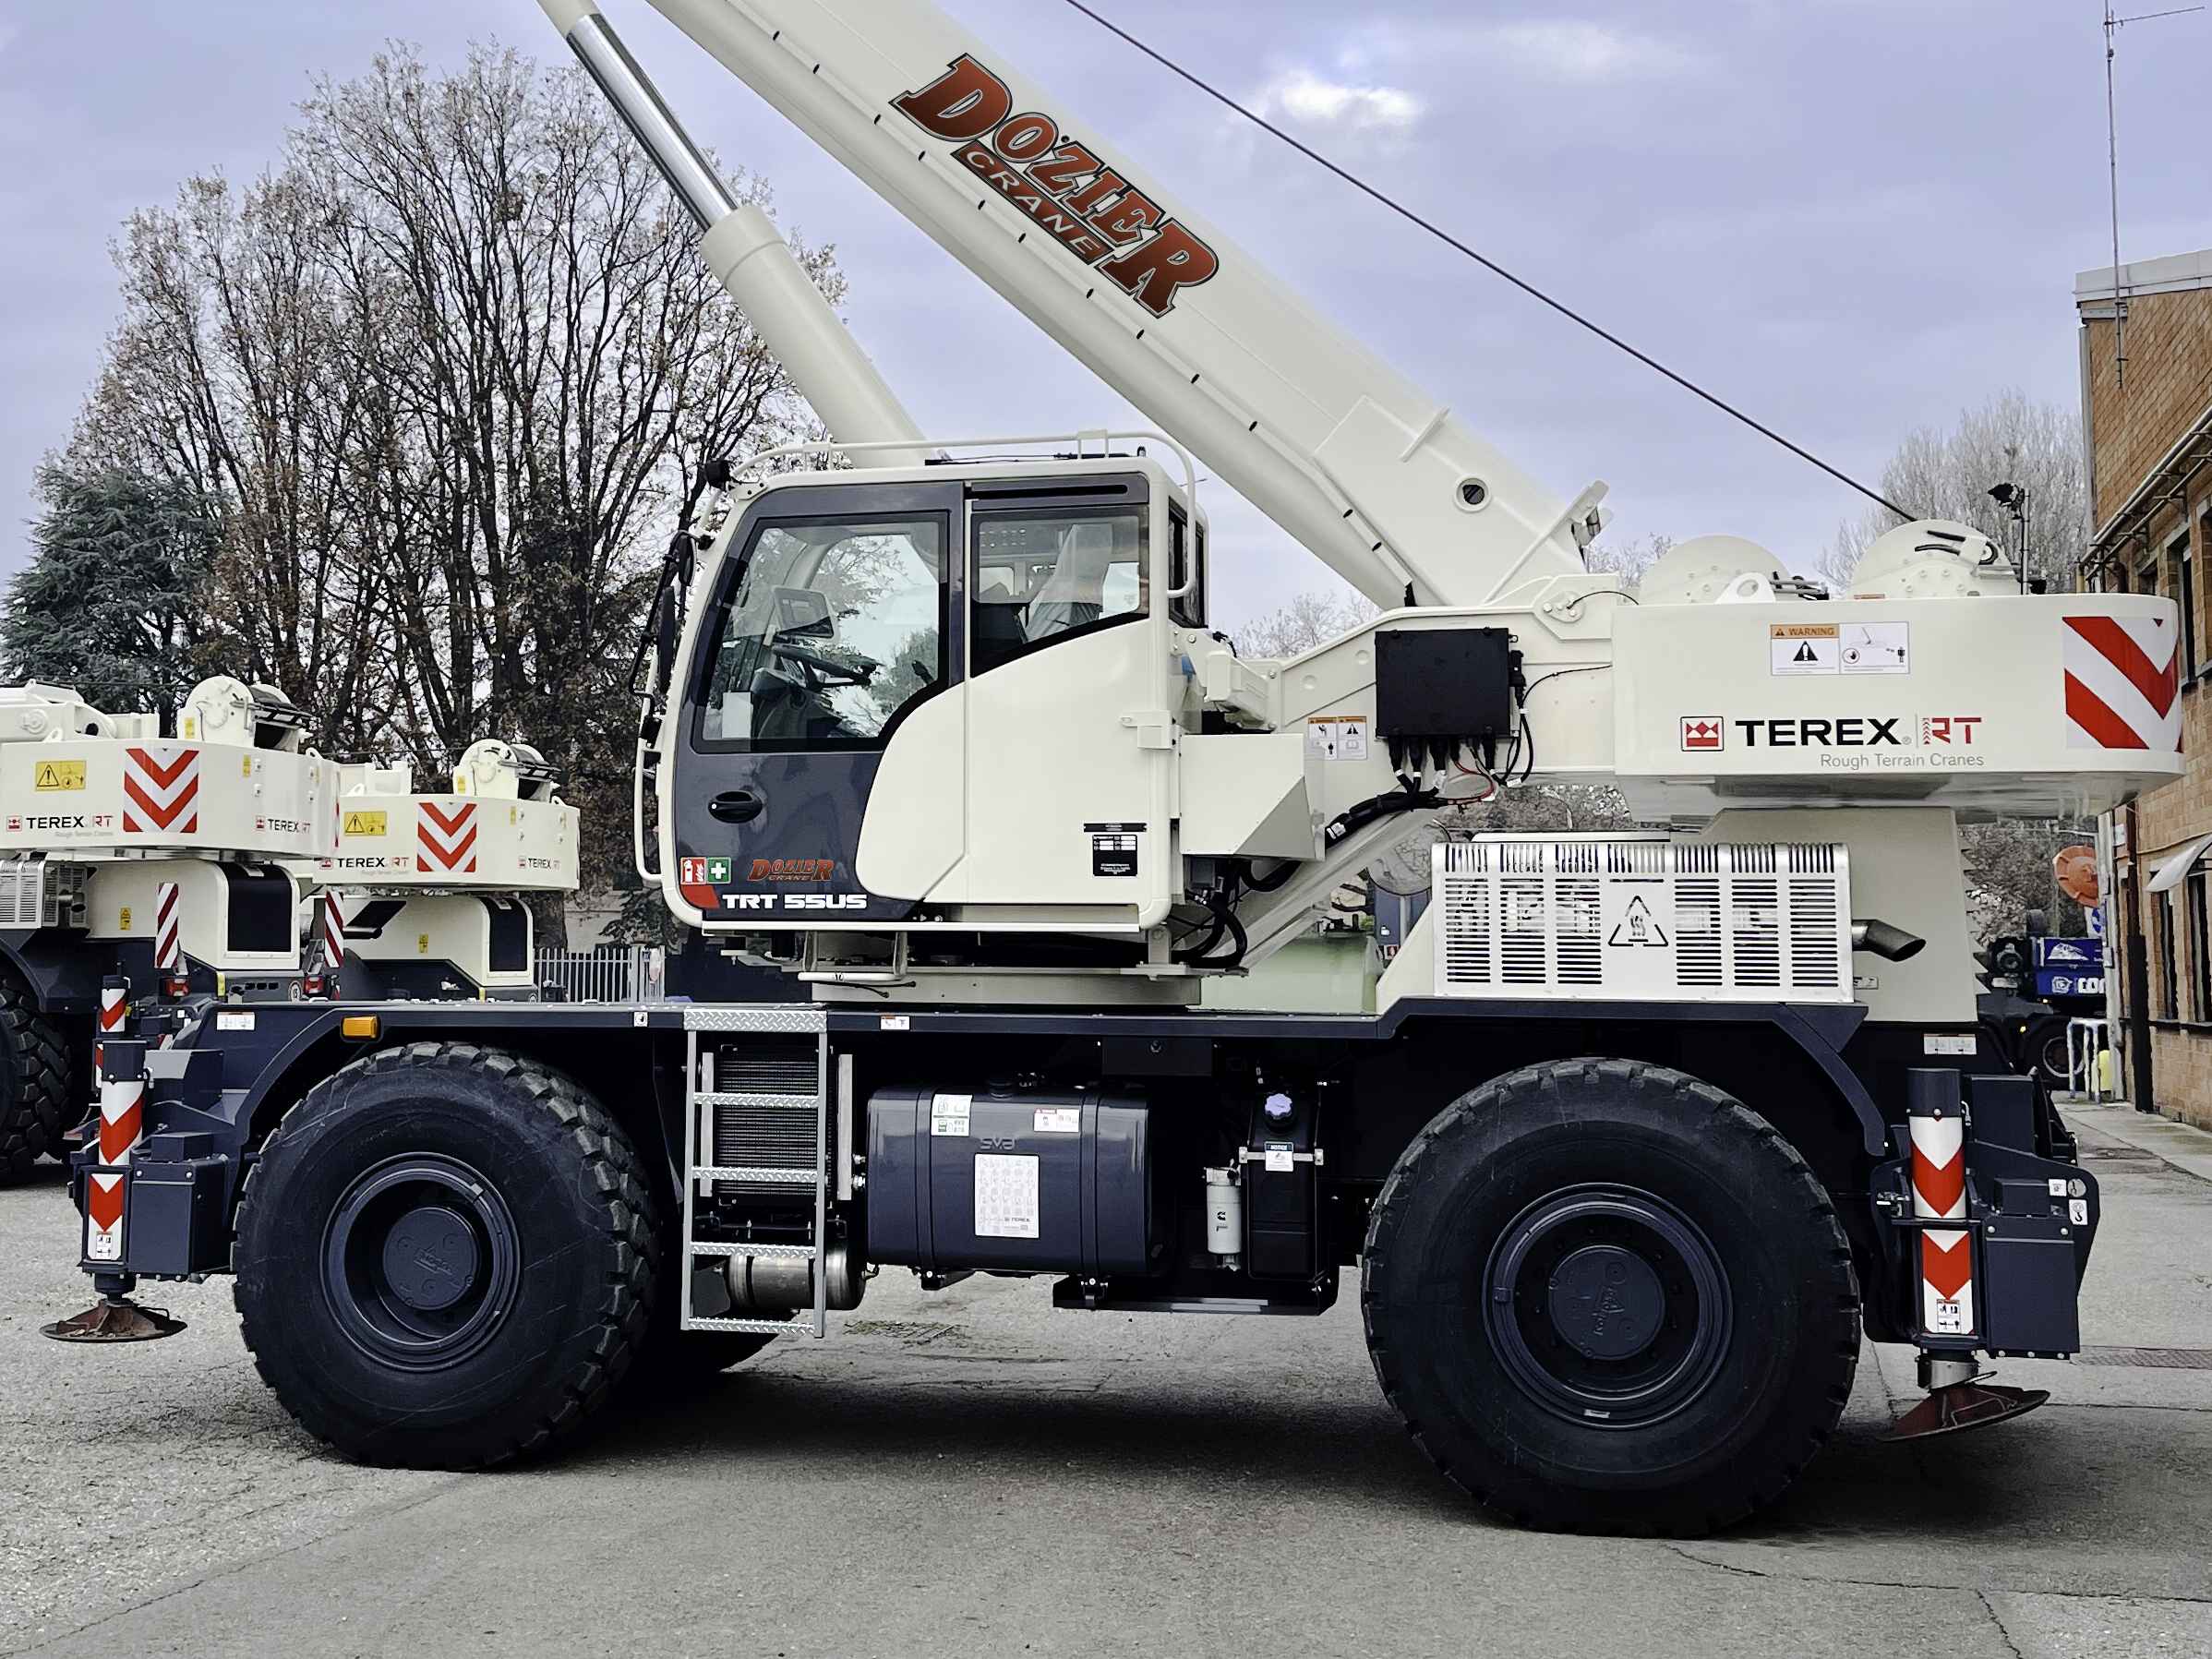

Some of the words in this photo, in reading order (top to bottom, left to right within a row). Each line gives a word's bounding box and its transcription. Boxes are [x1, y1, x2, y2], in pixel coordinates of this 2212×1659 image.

[888, 53, 1219, 319] DOZIER
[966, 150, 1102, 256] CRANE
[1788, 627, 1834, 636] WARNING
[1922, 717, 1982, 744] RT
[1821, 753, 1869, 771] Rough
[1875, 752, 1925, 767] Terrain
[1929, 752, 1985, 767] Cranes
[26, 815, 85, 829] TEREX
[93, 815, 113, 828] RT
[267, 818, 299, 833] TEREX
[337, 857, 386, 868] TEREX
[391, 857, 410, 868] RT
[528, 857, 551, 870] TEREX
[748, 859, 835, 882] DOZIER
[722, 894, 778, 909] TRT
[784, 894, 868, 909] 55US
